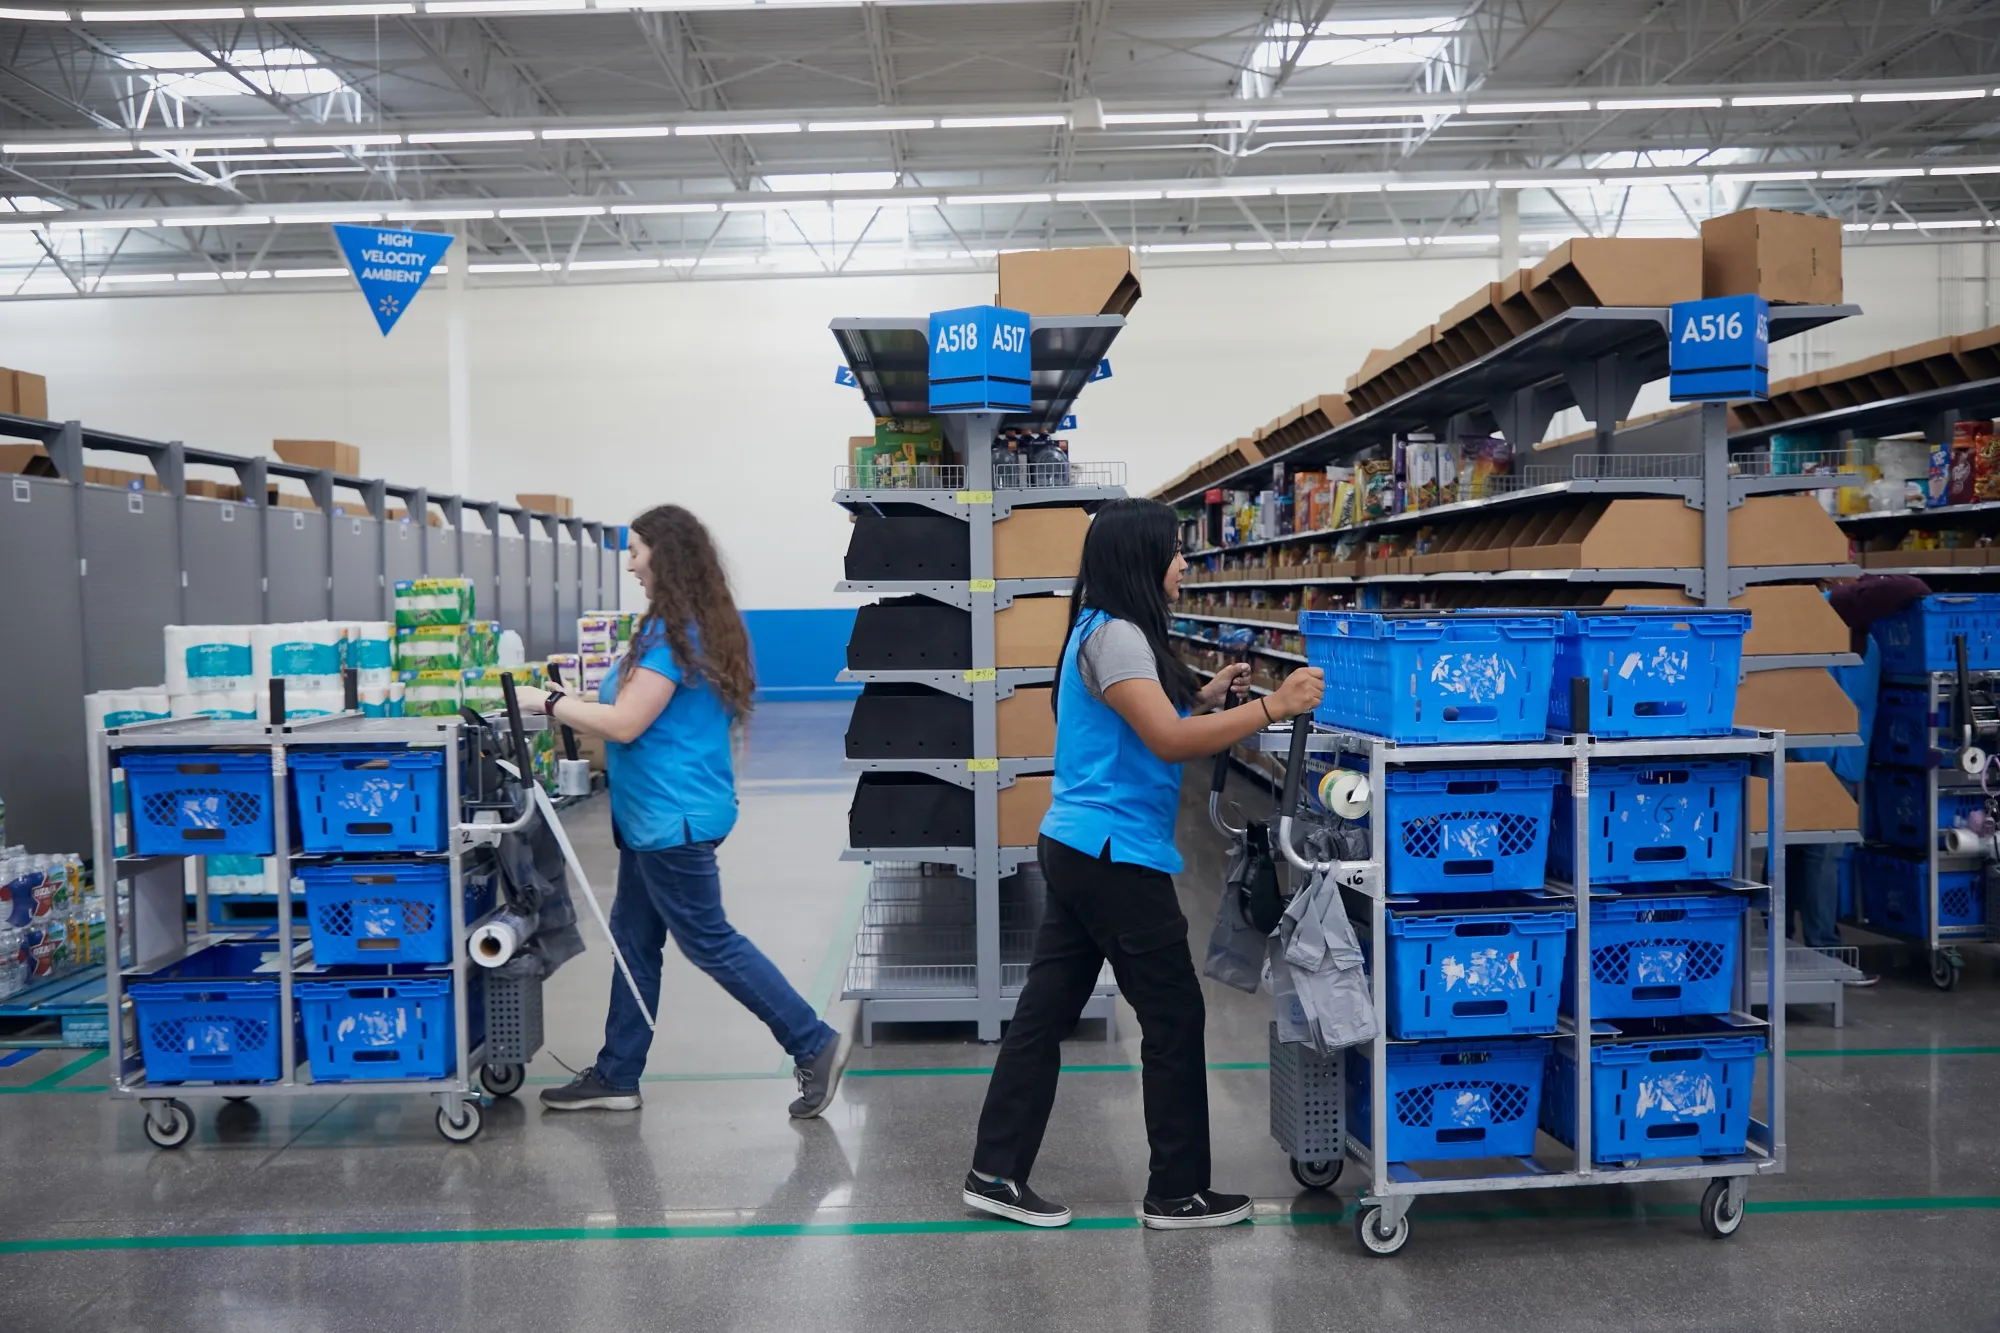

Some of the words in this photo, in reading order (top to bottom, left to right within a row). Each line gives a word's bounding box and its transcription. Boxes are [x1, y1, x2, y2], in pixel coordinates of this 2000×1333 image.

[377, 233, 414, 248] HIGH
[361, 249, 426, 267] VELOCITY
[361, 267, 422, 284] AMBIENT
[1681, 312, 1743, 344] A516
[936, 322, 978, 354] A518
[992, 323, 1026, 354] A517
[843, 370, 852, 384] 2
[1062, 417, 1071, 428] 4
[462, 830, 474, 845] 2
[1347, 869, 1364, 886] 16
